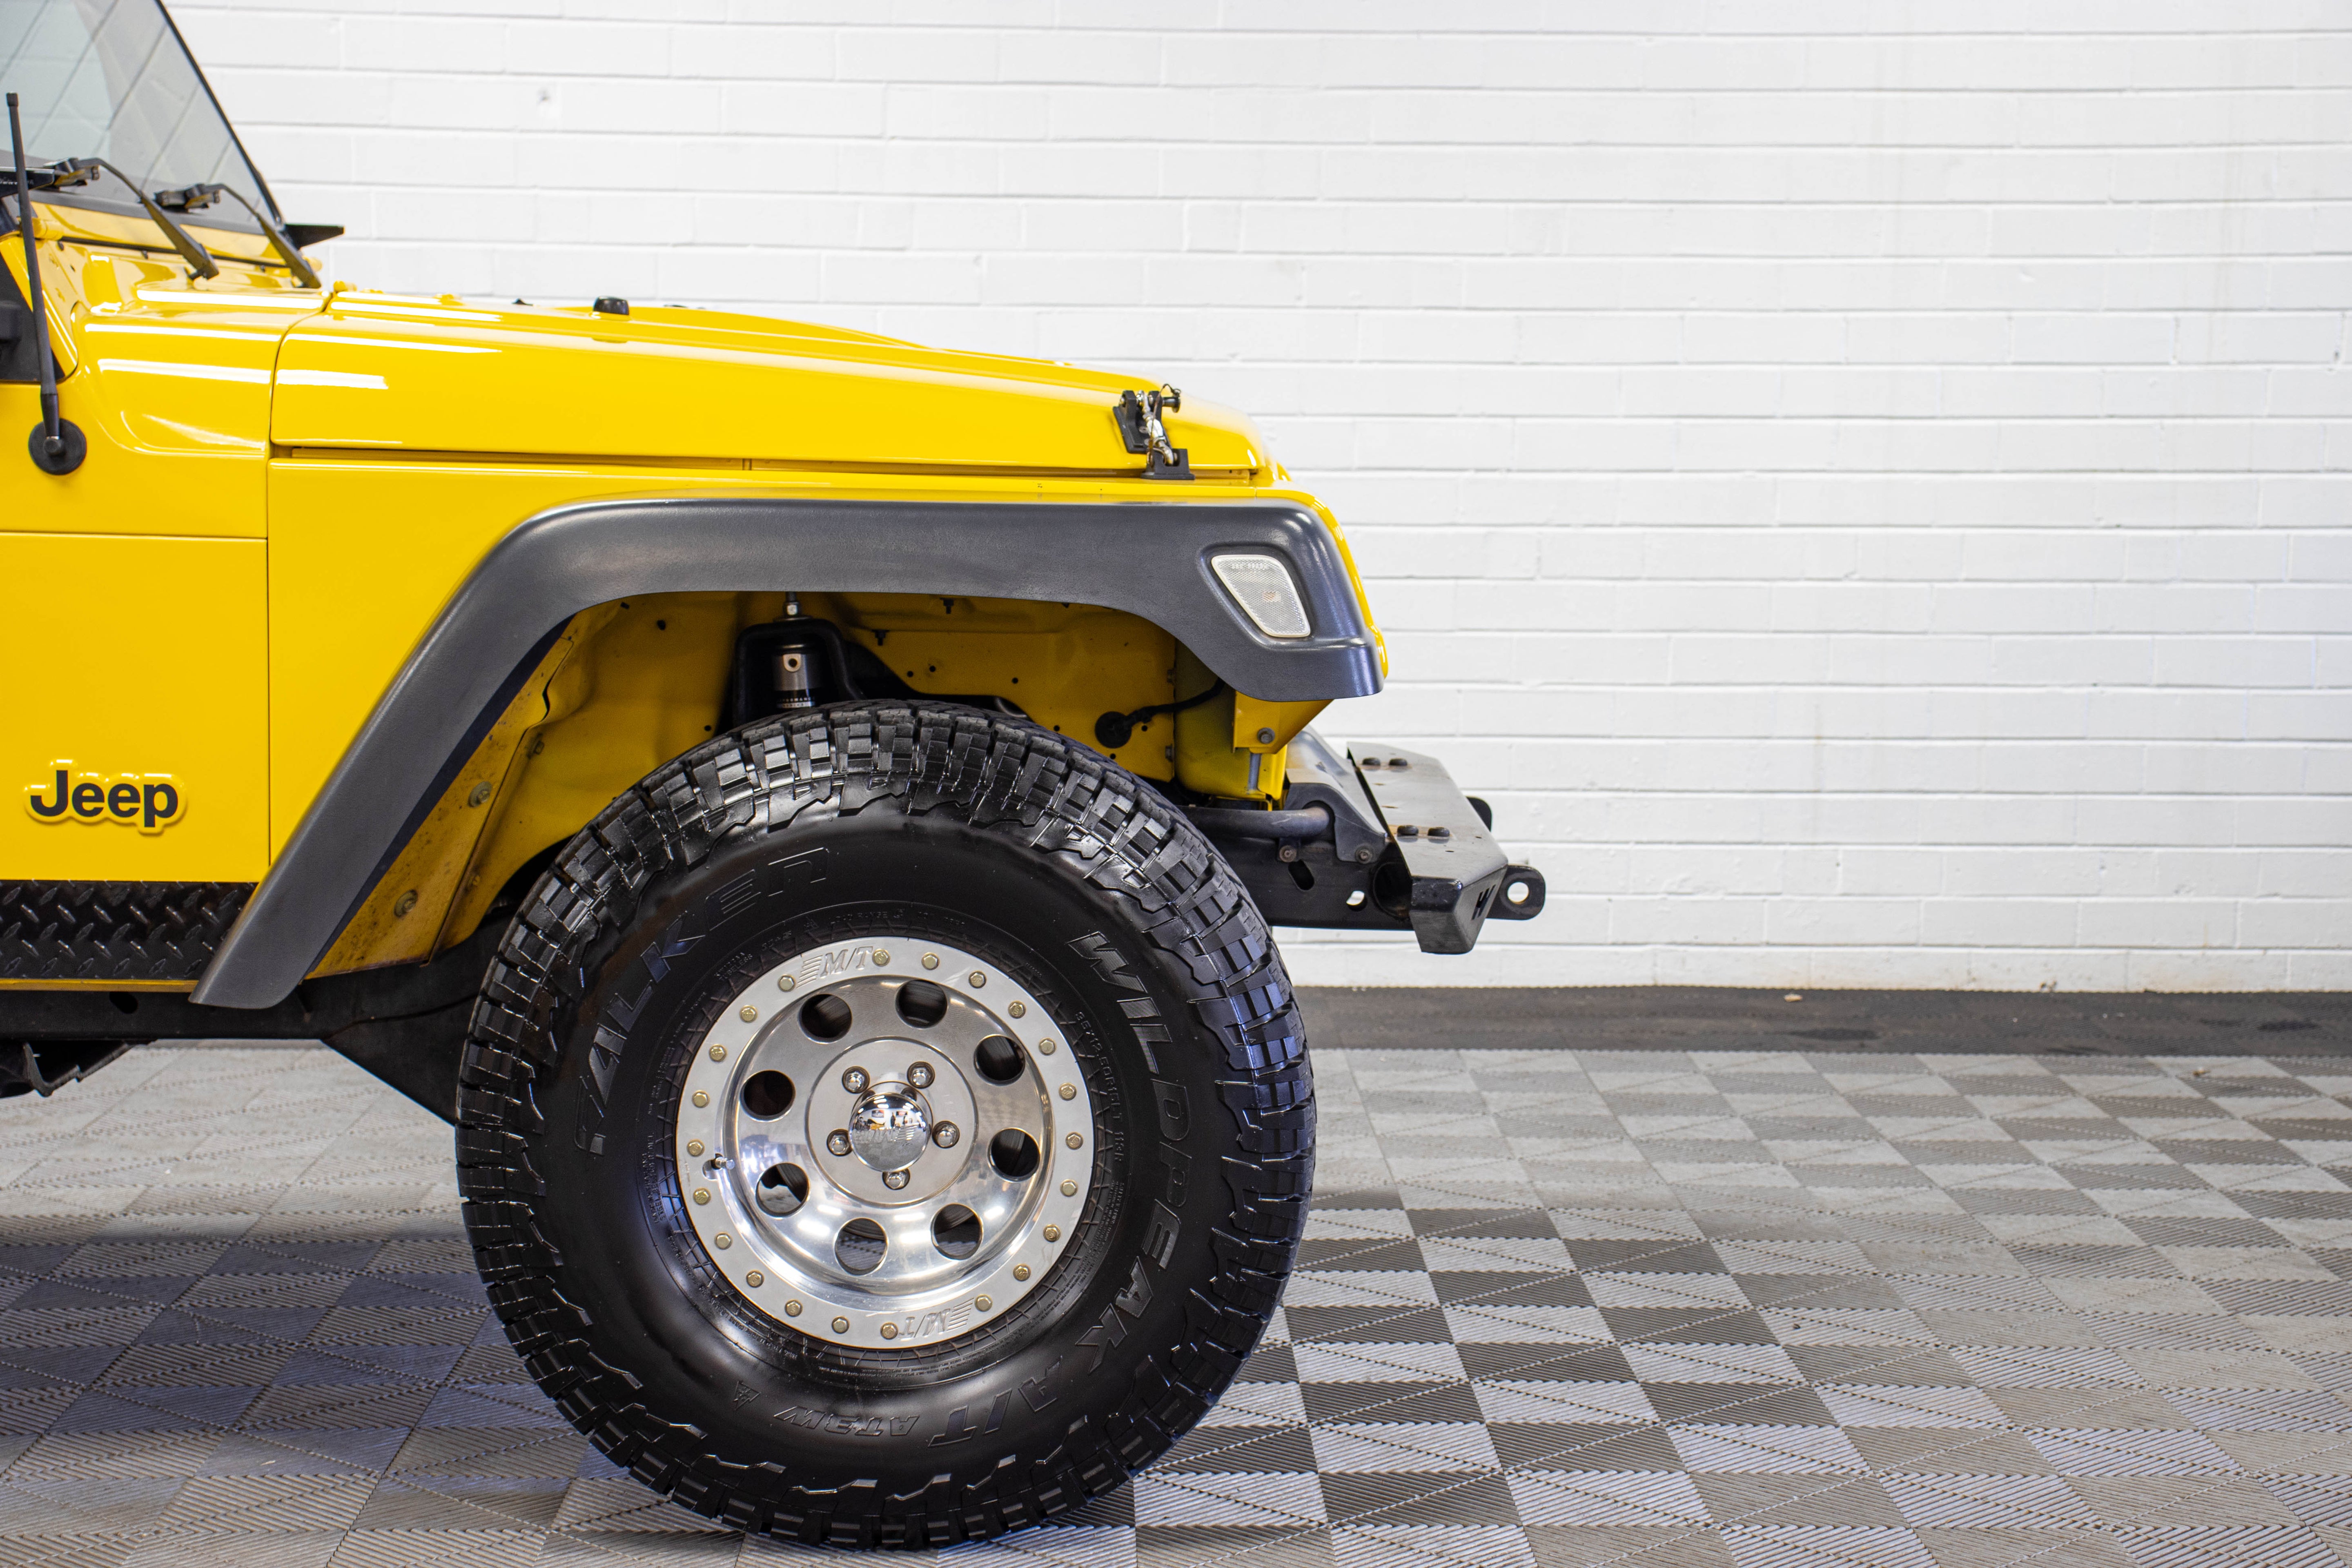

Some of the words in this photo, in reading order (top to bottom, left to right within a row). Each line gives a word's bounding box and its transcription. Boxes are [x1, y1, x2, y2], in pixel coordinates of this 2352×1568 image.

[30, 770, 178, 827] Jeep
[820, 946, 873, 978] M/T
[574, 847, 830, 1156] FALKEN
[1065, 931, 1192, 1375] WILDPEAK
[899, 1308, 951, 1341] M/T
[773, 1406, 920, 1437] AT3W
[928, 1355, 1062, 1448] A/T
